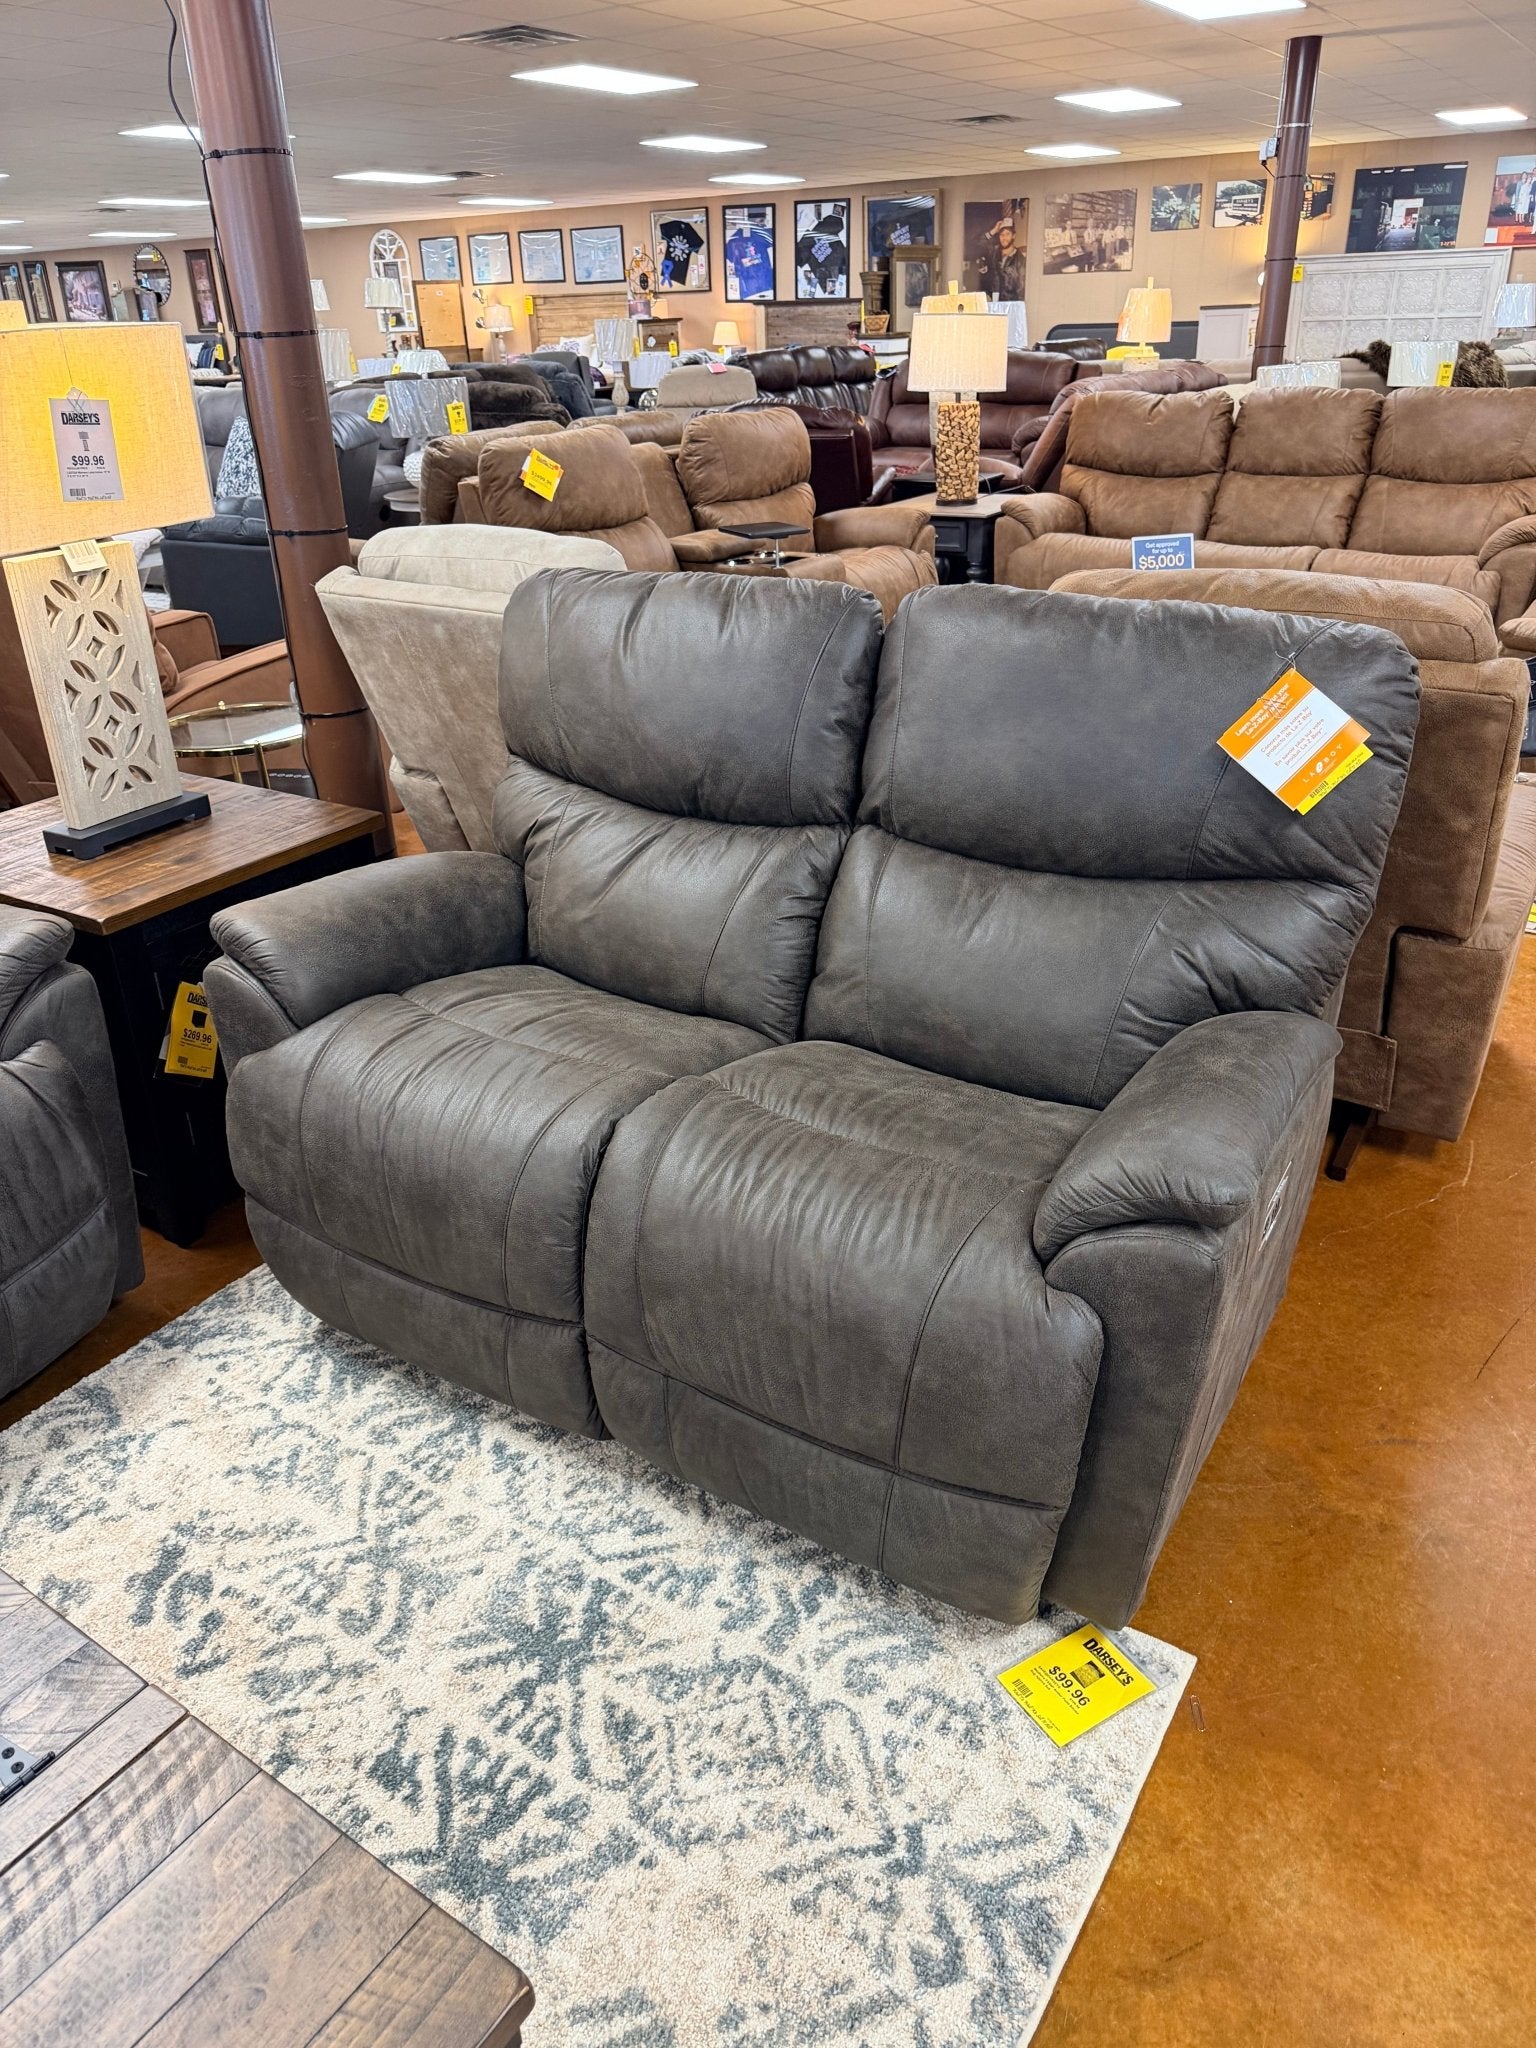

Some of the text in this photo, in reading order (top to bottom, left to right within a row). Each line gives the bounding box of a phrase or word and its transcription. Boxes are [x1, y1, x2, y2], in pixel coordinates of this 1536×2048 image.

[61, 412, 100, 425] DARSEY'S
[71, 455, 105, 466] $99.96
[1139, 554, 1184, 570] $5,000
[187, 992, 208, 1007] DARS
[183, 1028, 212, 1043] $269.96
[1082, 1637, 1135, 1687] DARSEY'S
[1048, 1666, 1091, 1706] $99.96
